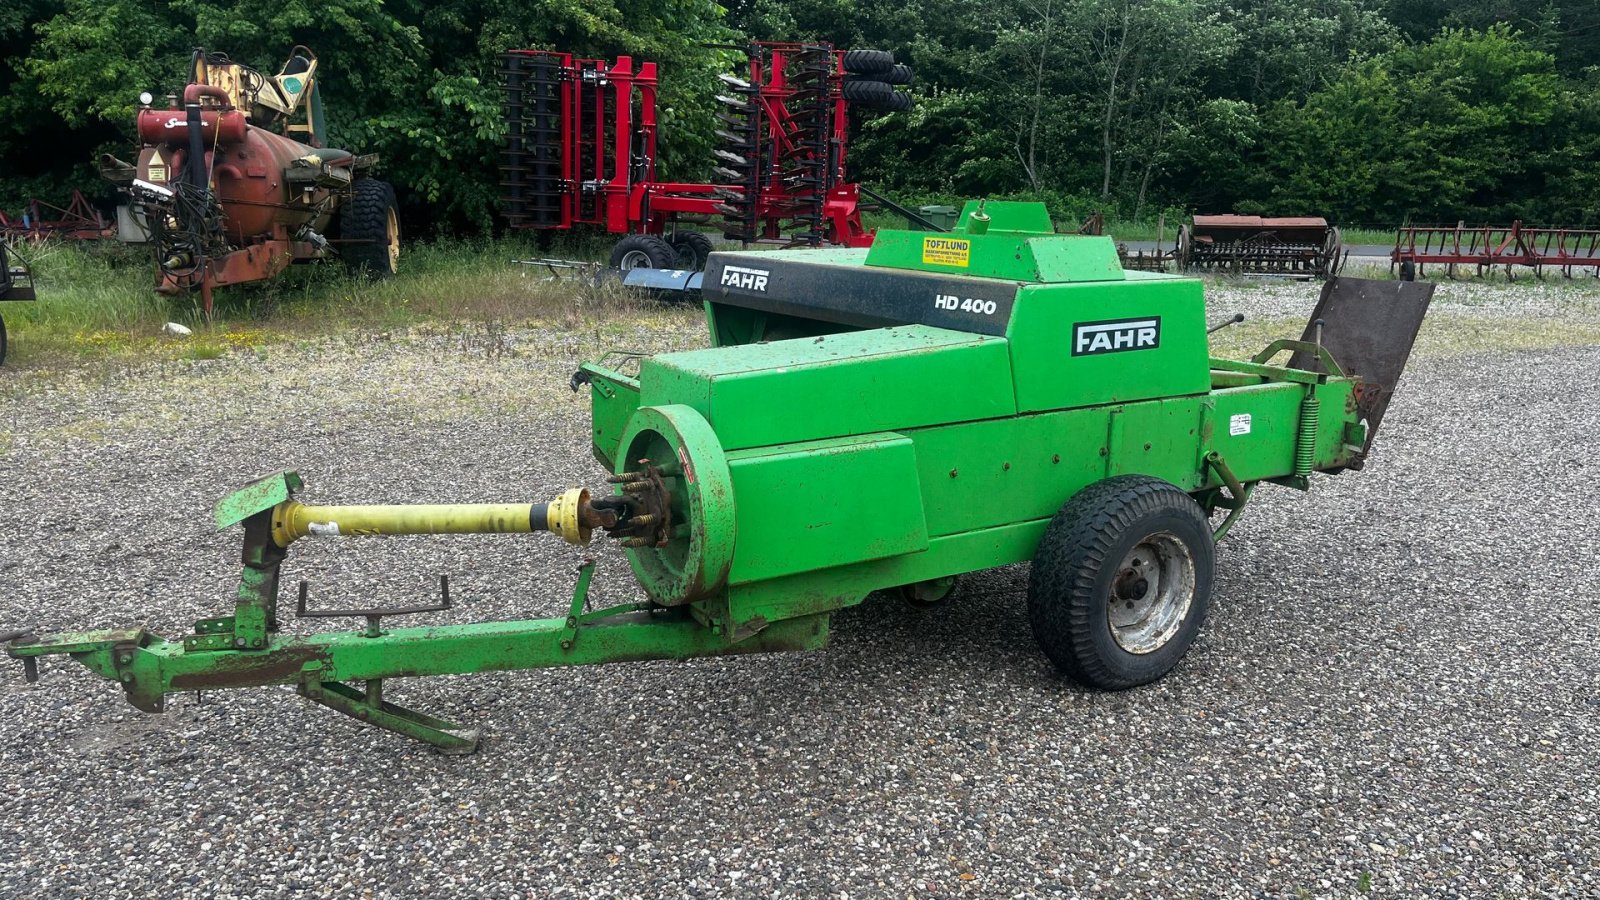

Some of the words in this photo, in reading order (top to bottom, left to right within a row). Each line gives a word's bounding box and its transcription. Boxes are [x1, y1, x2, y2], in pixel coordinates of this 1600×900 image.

[926, 240, 968, 250] TOFTLUND
[721, 265, 769, 291] FAHR
[935, 295, 959, 310] HD
[960, 298, 997, 315] 400
[1076, 320, 1157, 353] FAHR
